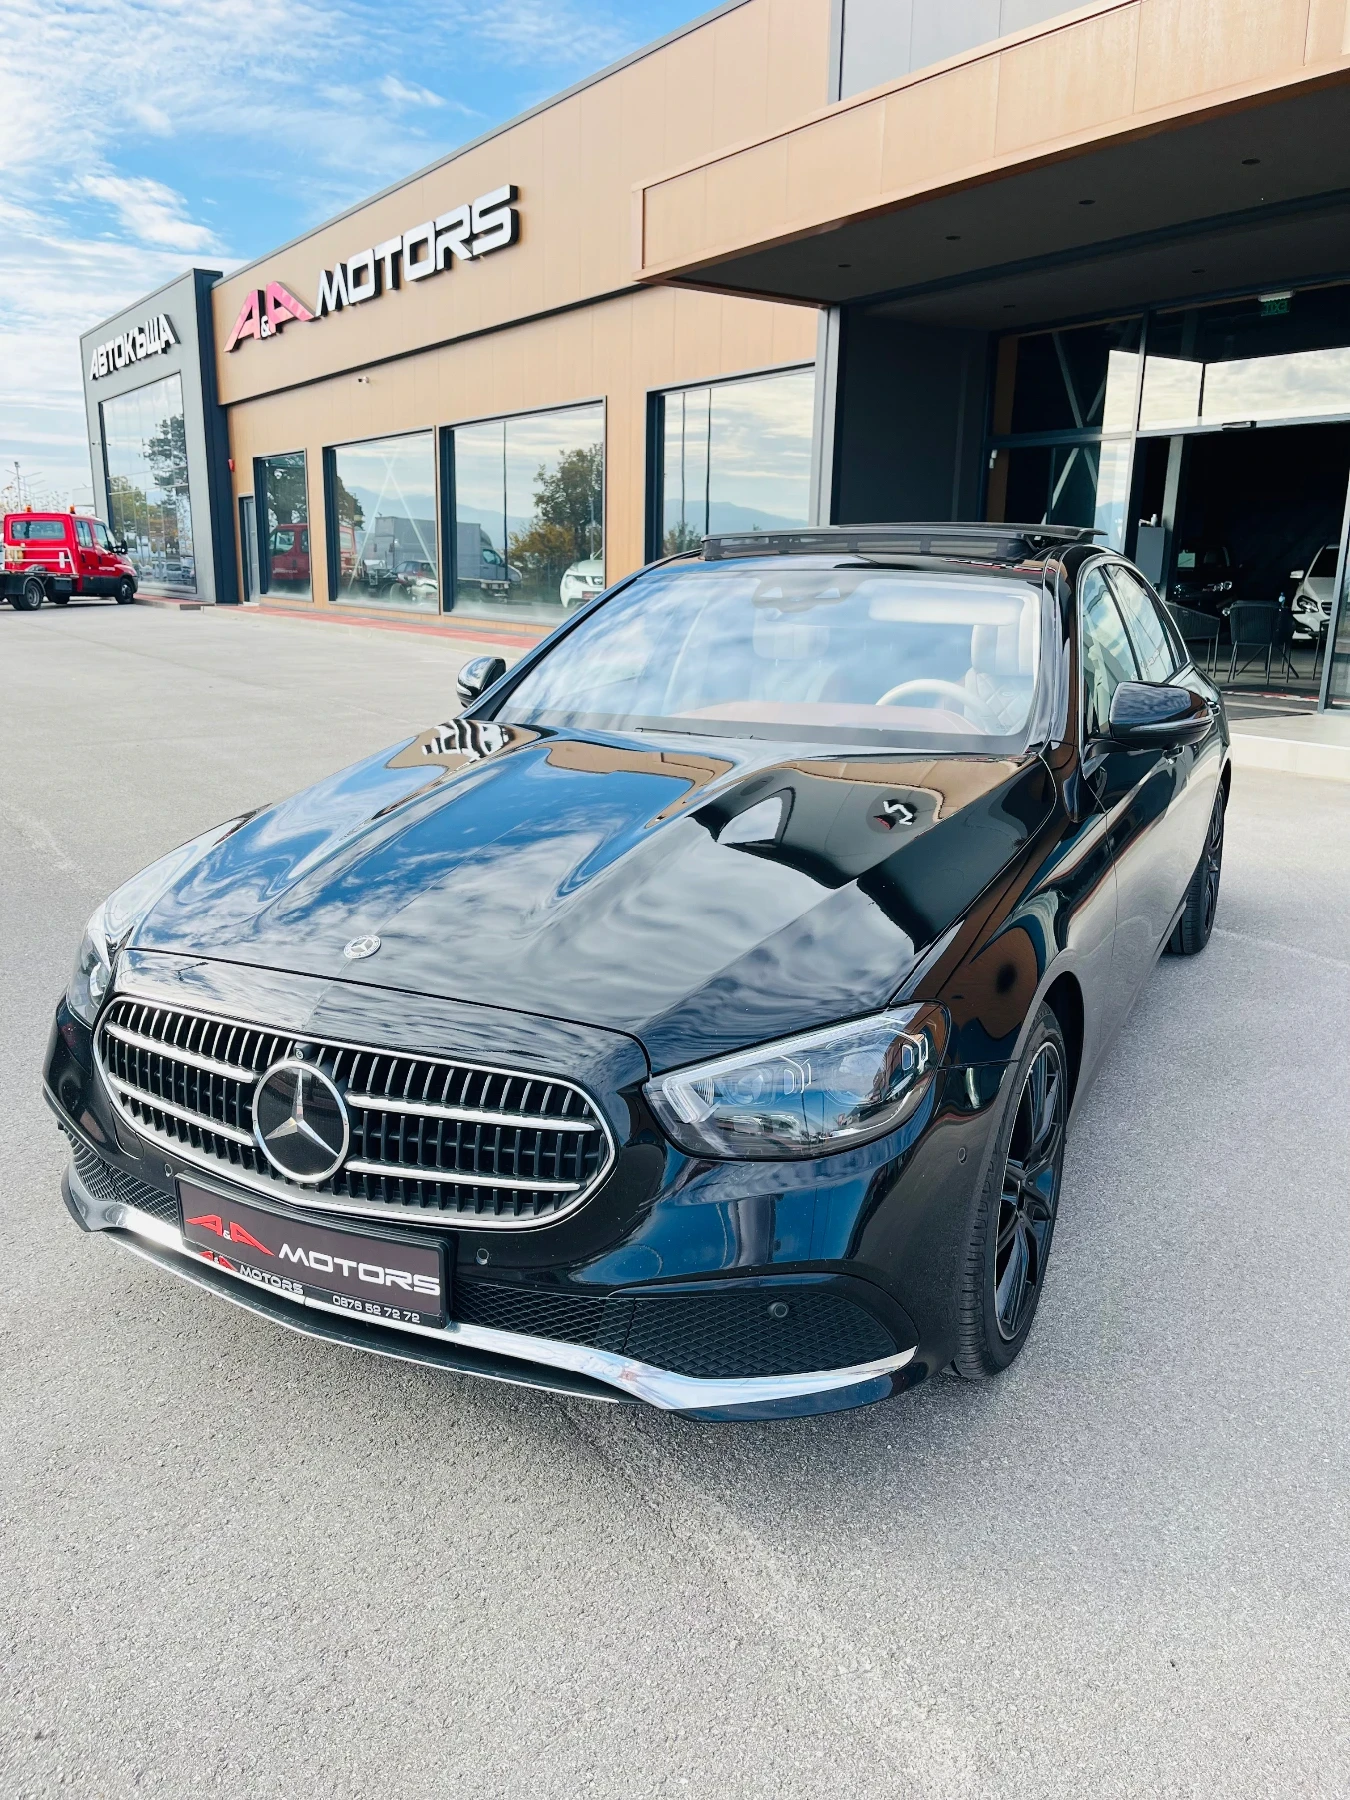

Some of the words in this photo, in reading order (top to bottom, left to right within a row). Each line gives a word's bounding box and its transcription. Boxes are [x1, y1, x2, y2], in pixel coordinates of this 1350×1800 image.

[224, 280, 316, 353] A&A
[315, 184, 518, 318] MOTORS
[89, 313, 178, 381] АВТОКЪЩА
[185, 1214, 276, 1257] A&A
[278, 1243, 441, 1296] MOTORS
[239, 1264, 304, 1295] MOTORS
[383, 1306, 401, 1320] 72
[402, 1310, 421, 1324] 72
